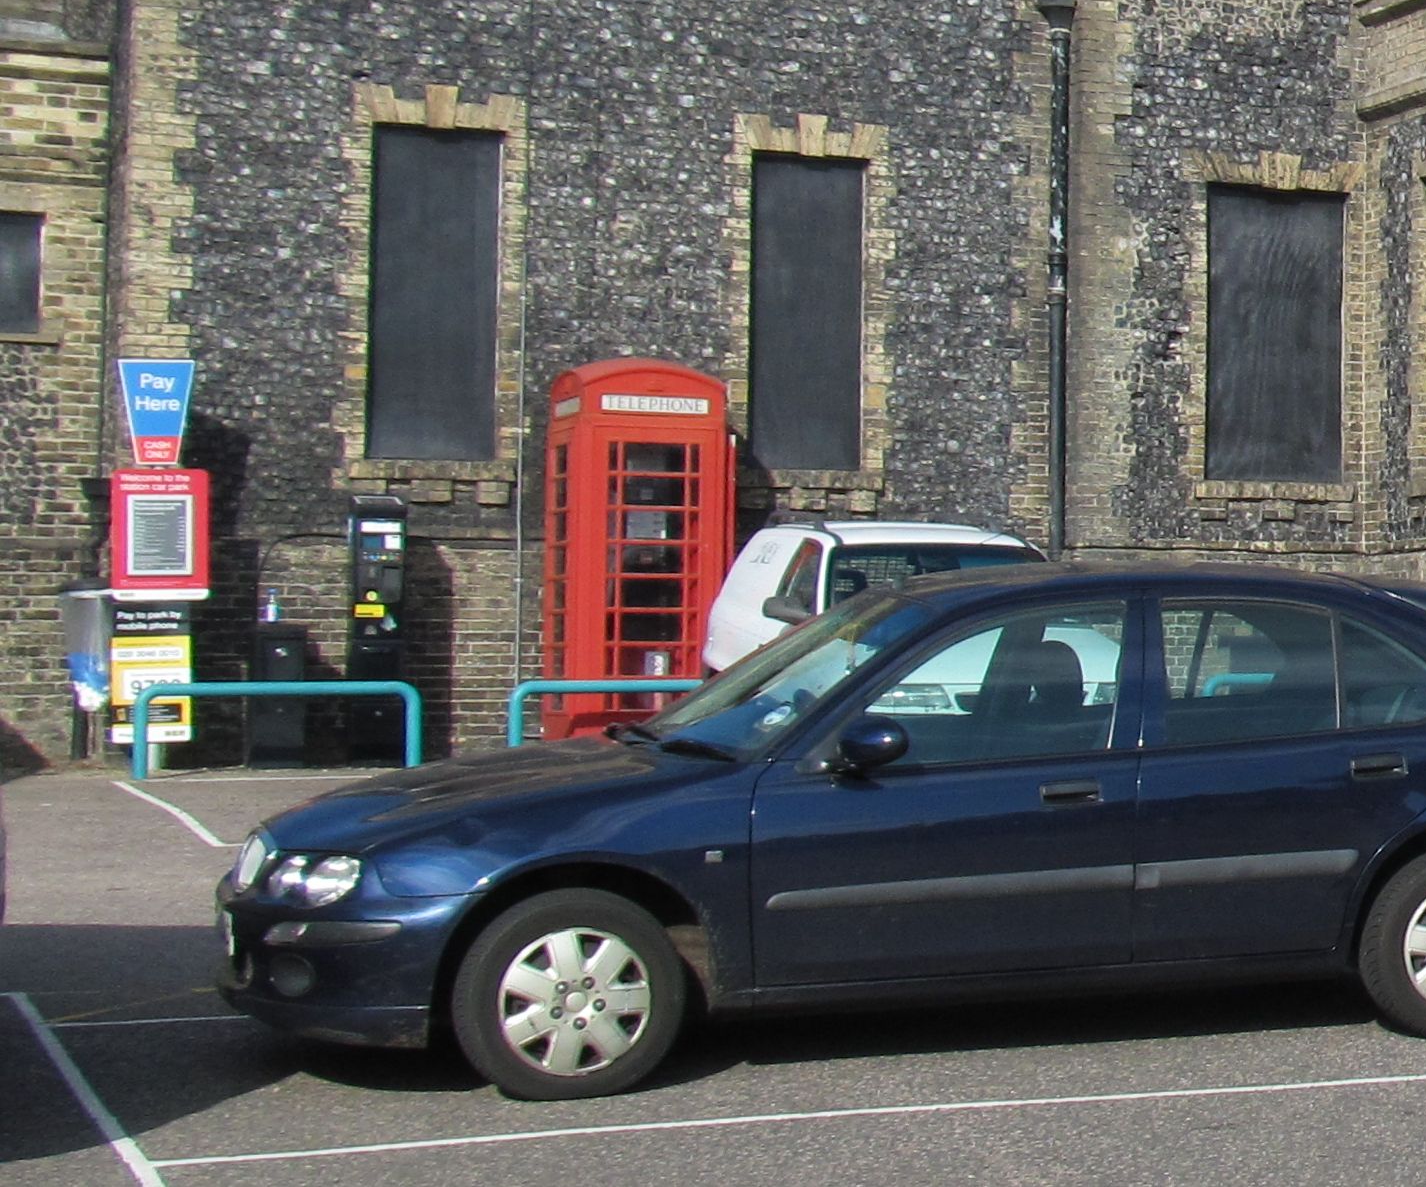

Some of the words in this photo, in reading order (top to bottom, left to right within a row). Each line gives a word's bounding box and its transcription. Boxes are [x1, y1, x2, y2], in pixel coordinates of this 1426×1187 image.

[140, 373, 176, 393] Pay
[135, 395, 180, 411] Here
[607, 395, 704, 412] TELEPHONE
[143, 440, 171, 449] CASH
[144, 450, 170, 459] ONLY
[120, 474, 162, 482] Welcome
[164, 474, 174, 482] to
[175, 474, 191, 482] the
[120, 483, 150, 491] station
[167, 484, 190, 492] park
[116, 611, 135, 621] Pay
[147, 611, 168, 620] park
[169, 611, 182, 620] by
[116, 622, 147, 630] mobile
[149, 622, 178, 630] phone
[130, 679, 182, 695] 97
